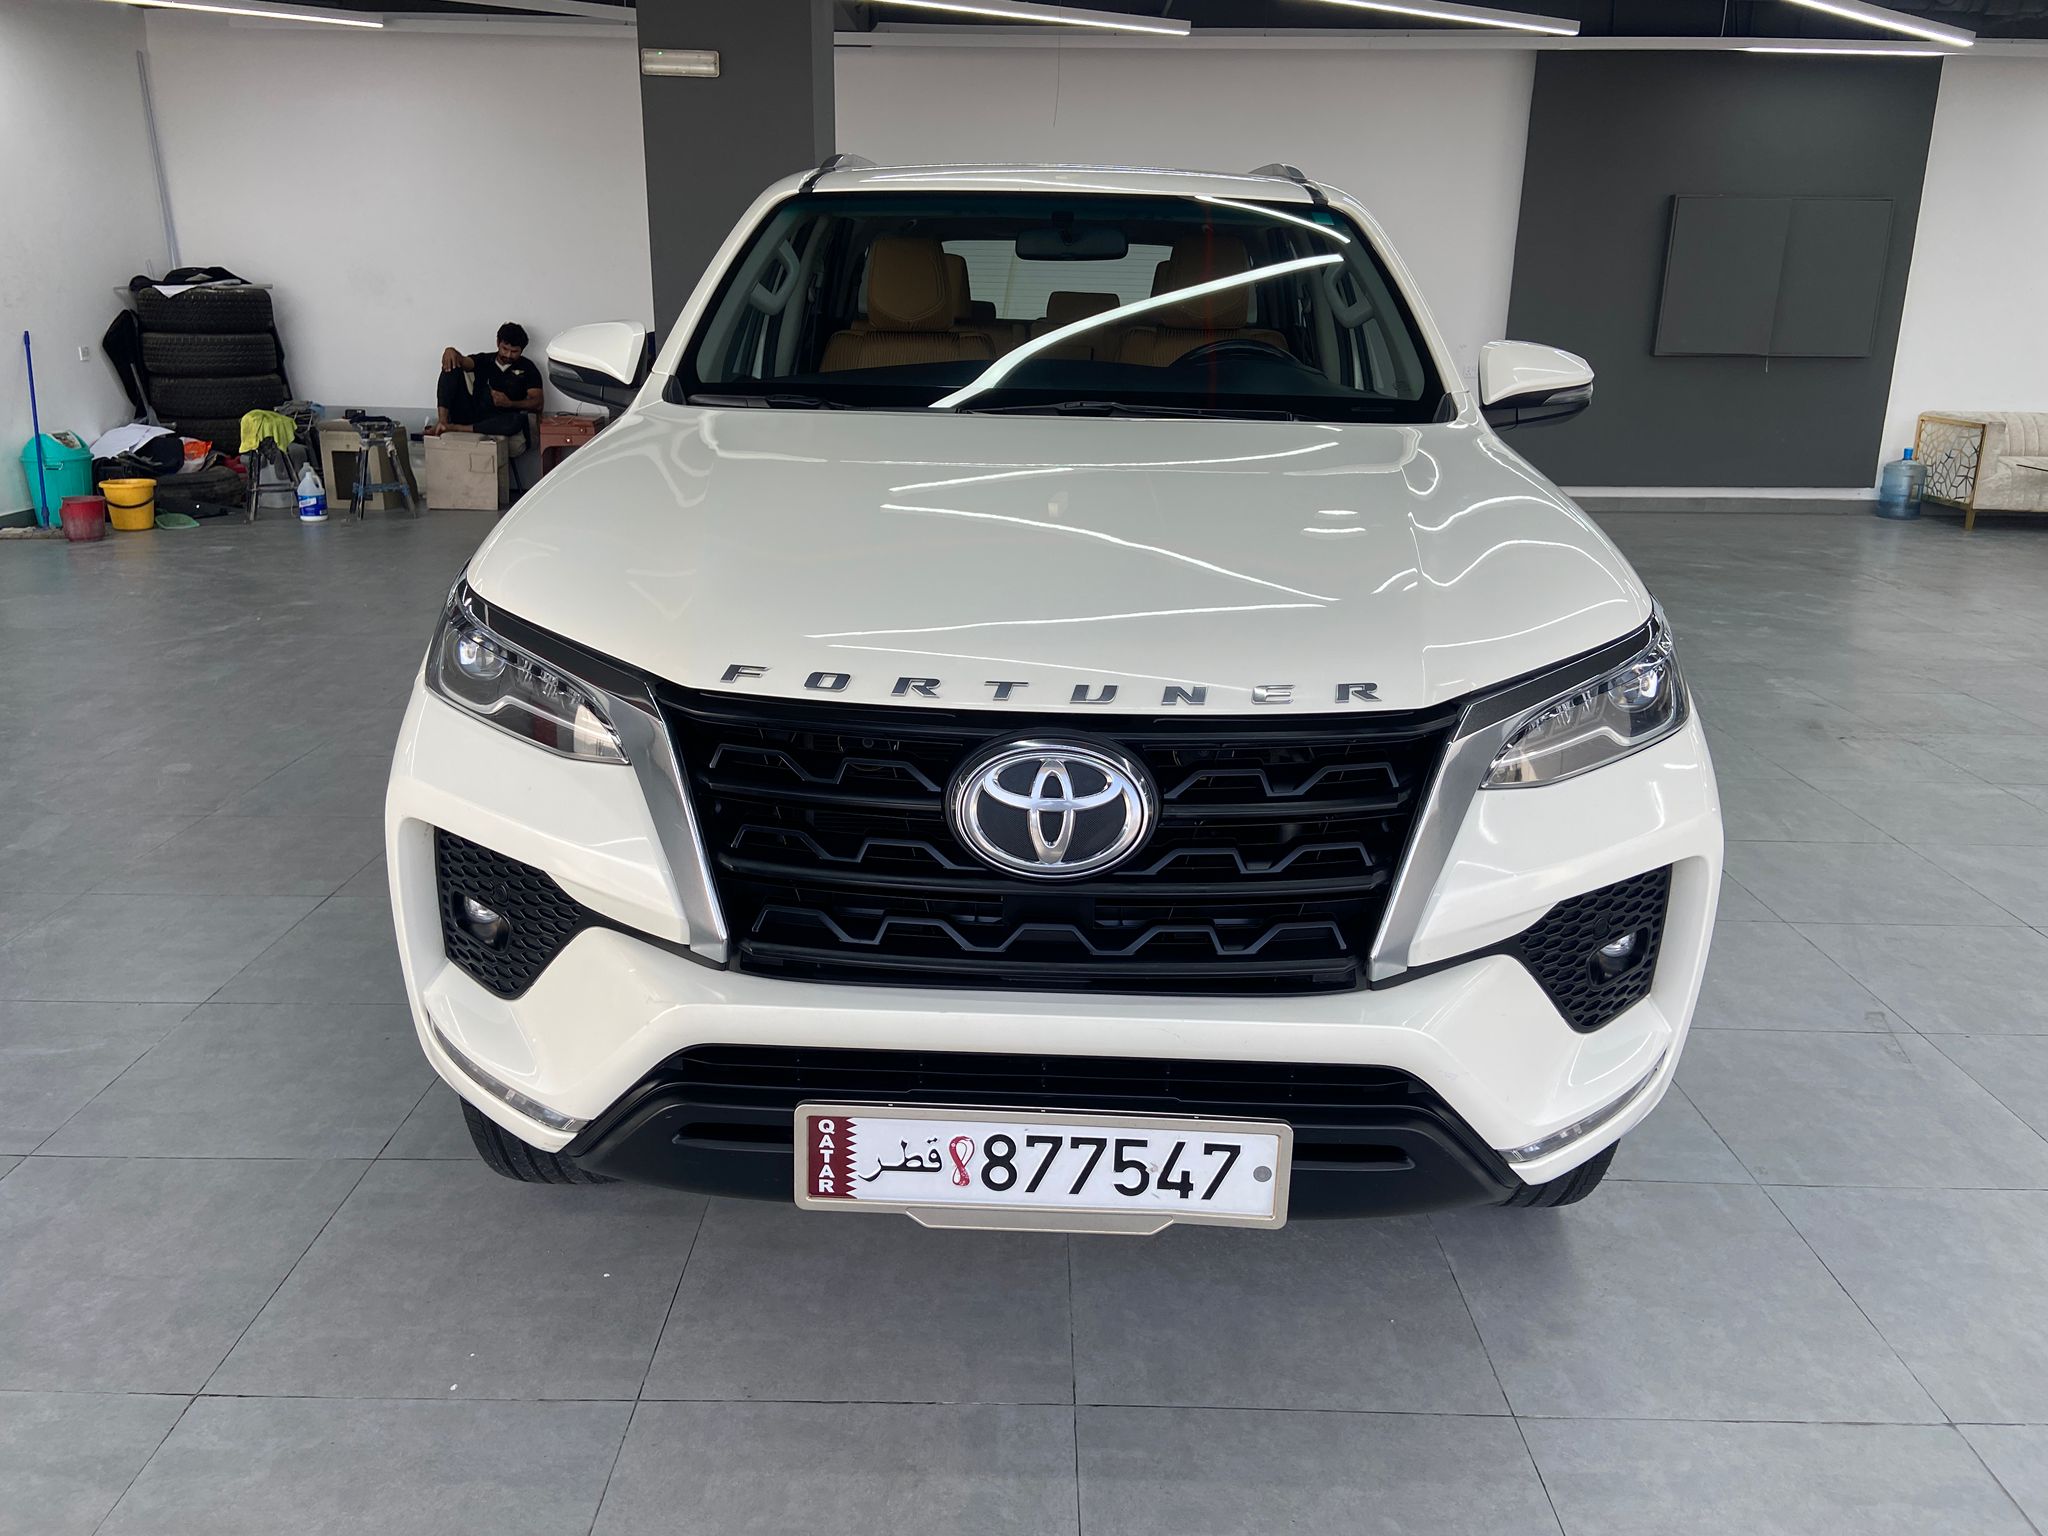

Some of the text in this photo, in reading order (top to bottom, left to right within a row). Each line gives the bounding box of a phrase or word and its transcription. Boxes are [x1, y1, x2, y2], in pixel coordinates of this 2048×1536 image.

[720, 664, 1381, 706] FORTUNER
[818, 1119, 836, 1194] QATAR
[858, 1137, 943, 1182] قطر
[981, 1134, 1241, 1200] 877547
